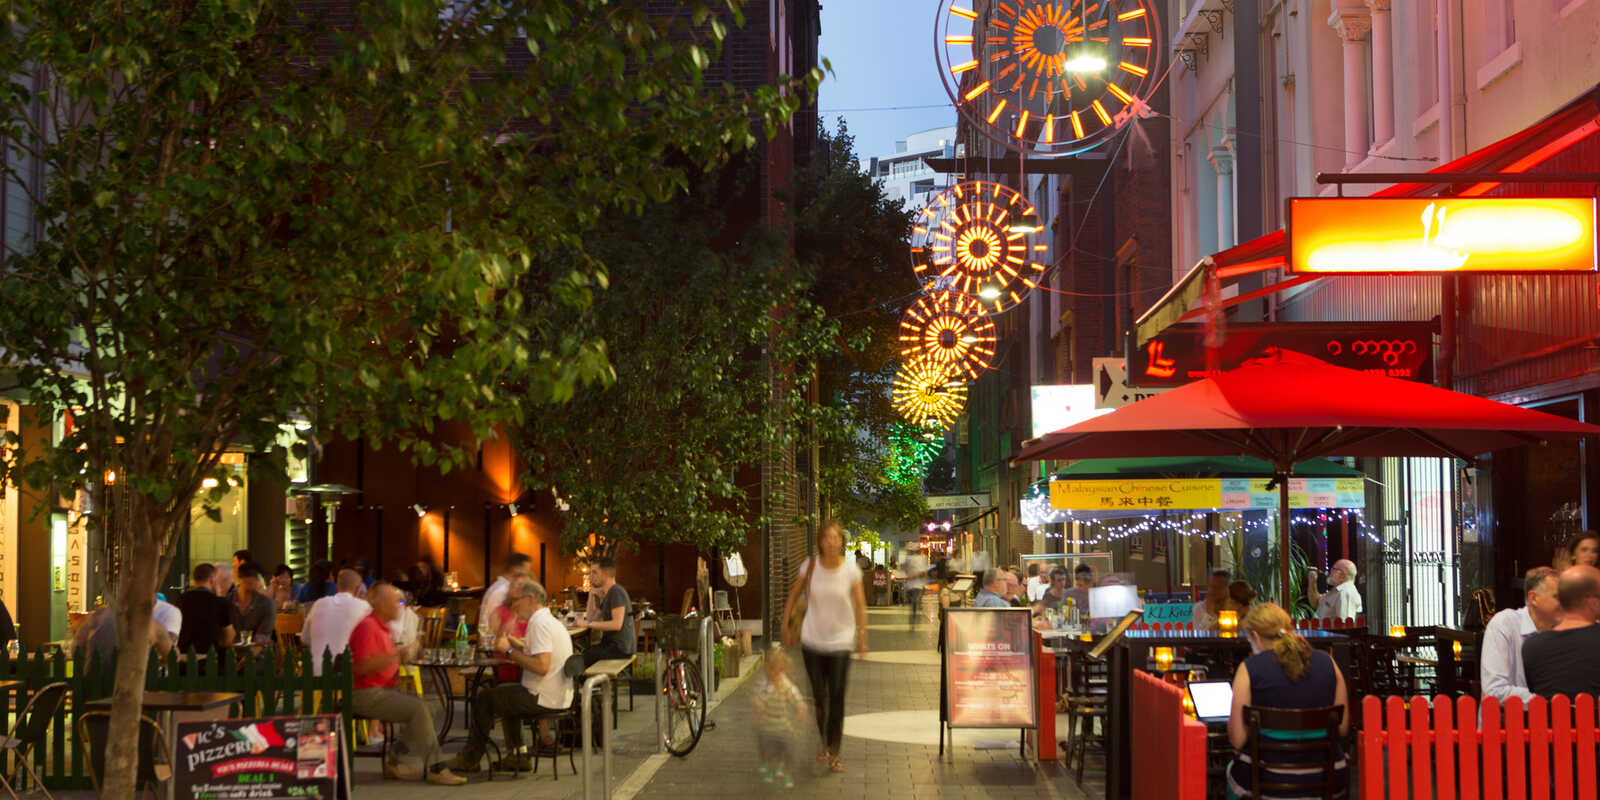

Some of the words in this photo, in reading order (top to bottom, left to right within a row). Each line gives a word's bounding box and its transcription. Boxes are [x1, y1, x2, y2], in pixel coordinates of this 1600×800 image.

[1057, 483, 1117, 495] Malaysian
[1118, 482, 1167, 494] Chinese
[1168, 481, 1215, 493] Cuisine
[1147, 606, 1167, 619] KL
[238, 773, 266, 782] DEAL
